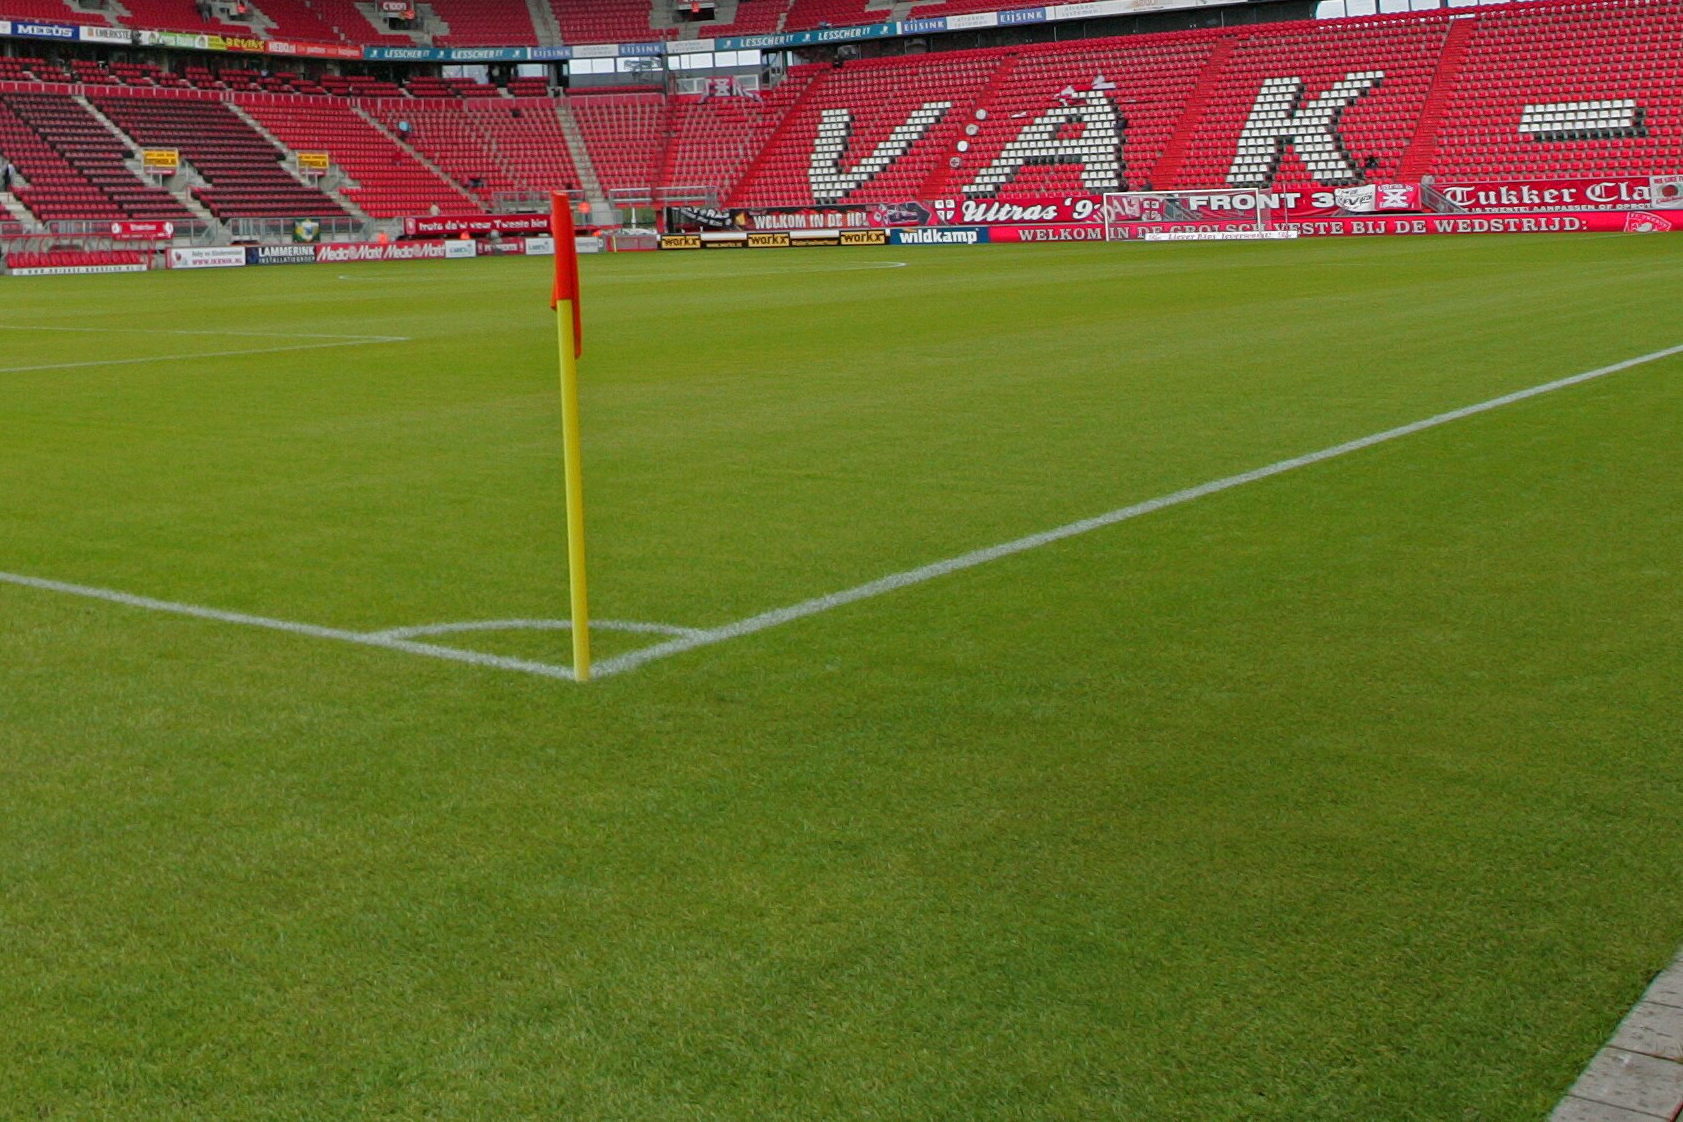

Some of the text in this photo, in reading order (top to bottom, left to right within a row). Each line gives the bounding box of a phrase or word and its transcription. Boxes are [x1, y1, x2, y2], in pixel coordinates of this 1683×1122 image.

[740, 35, 784, 48] LESSCHER
[817, 29, 862, 41] LESSCHER
[384, 49, 421, 59] LESSCHER
[451, 49, 495, 59] LESSCHER
[808, 69, 1386, 199] VAK
[1189, 193, 1302, 211] FRONT
[1443, 184, 1577, 207] Tukker
[962, 199, 1058, 222] Ultras
[754, 214, 806, 229] WELKOM
[810, 213, 824, 228] IN
[828, 213, 843, 227] DE
[1019, 228, 1102, 241] WELKOM
[1109, 226, 1130, 239] IN
[1138, 226, 1165, 238] DE
[1273, 220, 1344, 235] VESTE
[1351, 220, 1386, 234] BIJ
[1395, 219, 1427, 234] DE
[1433, 217, 1588, 233] WEDSTRIJD:
[899, 228, 978, 245] wildkamp
[258, 246, 315, 258] LAMMERINK
